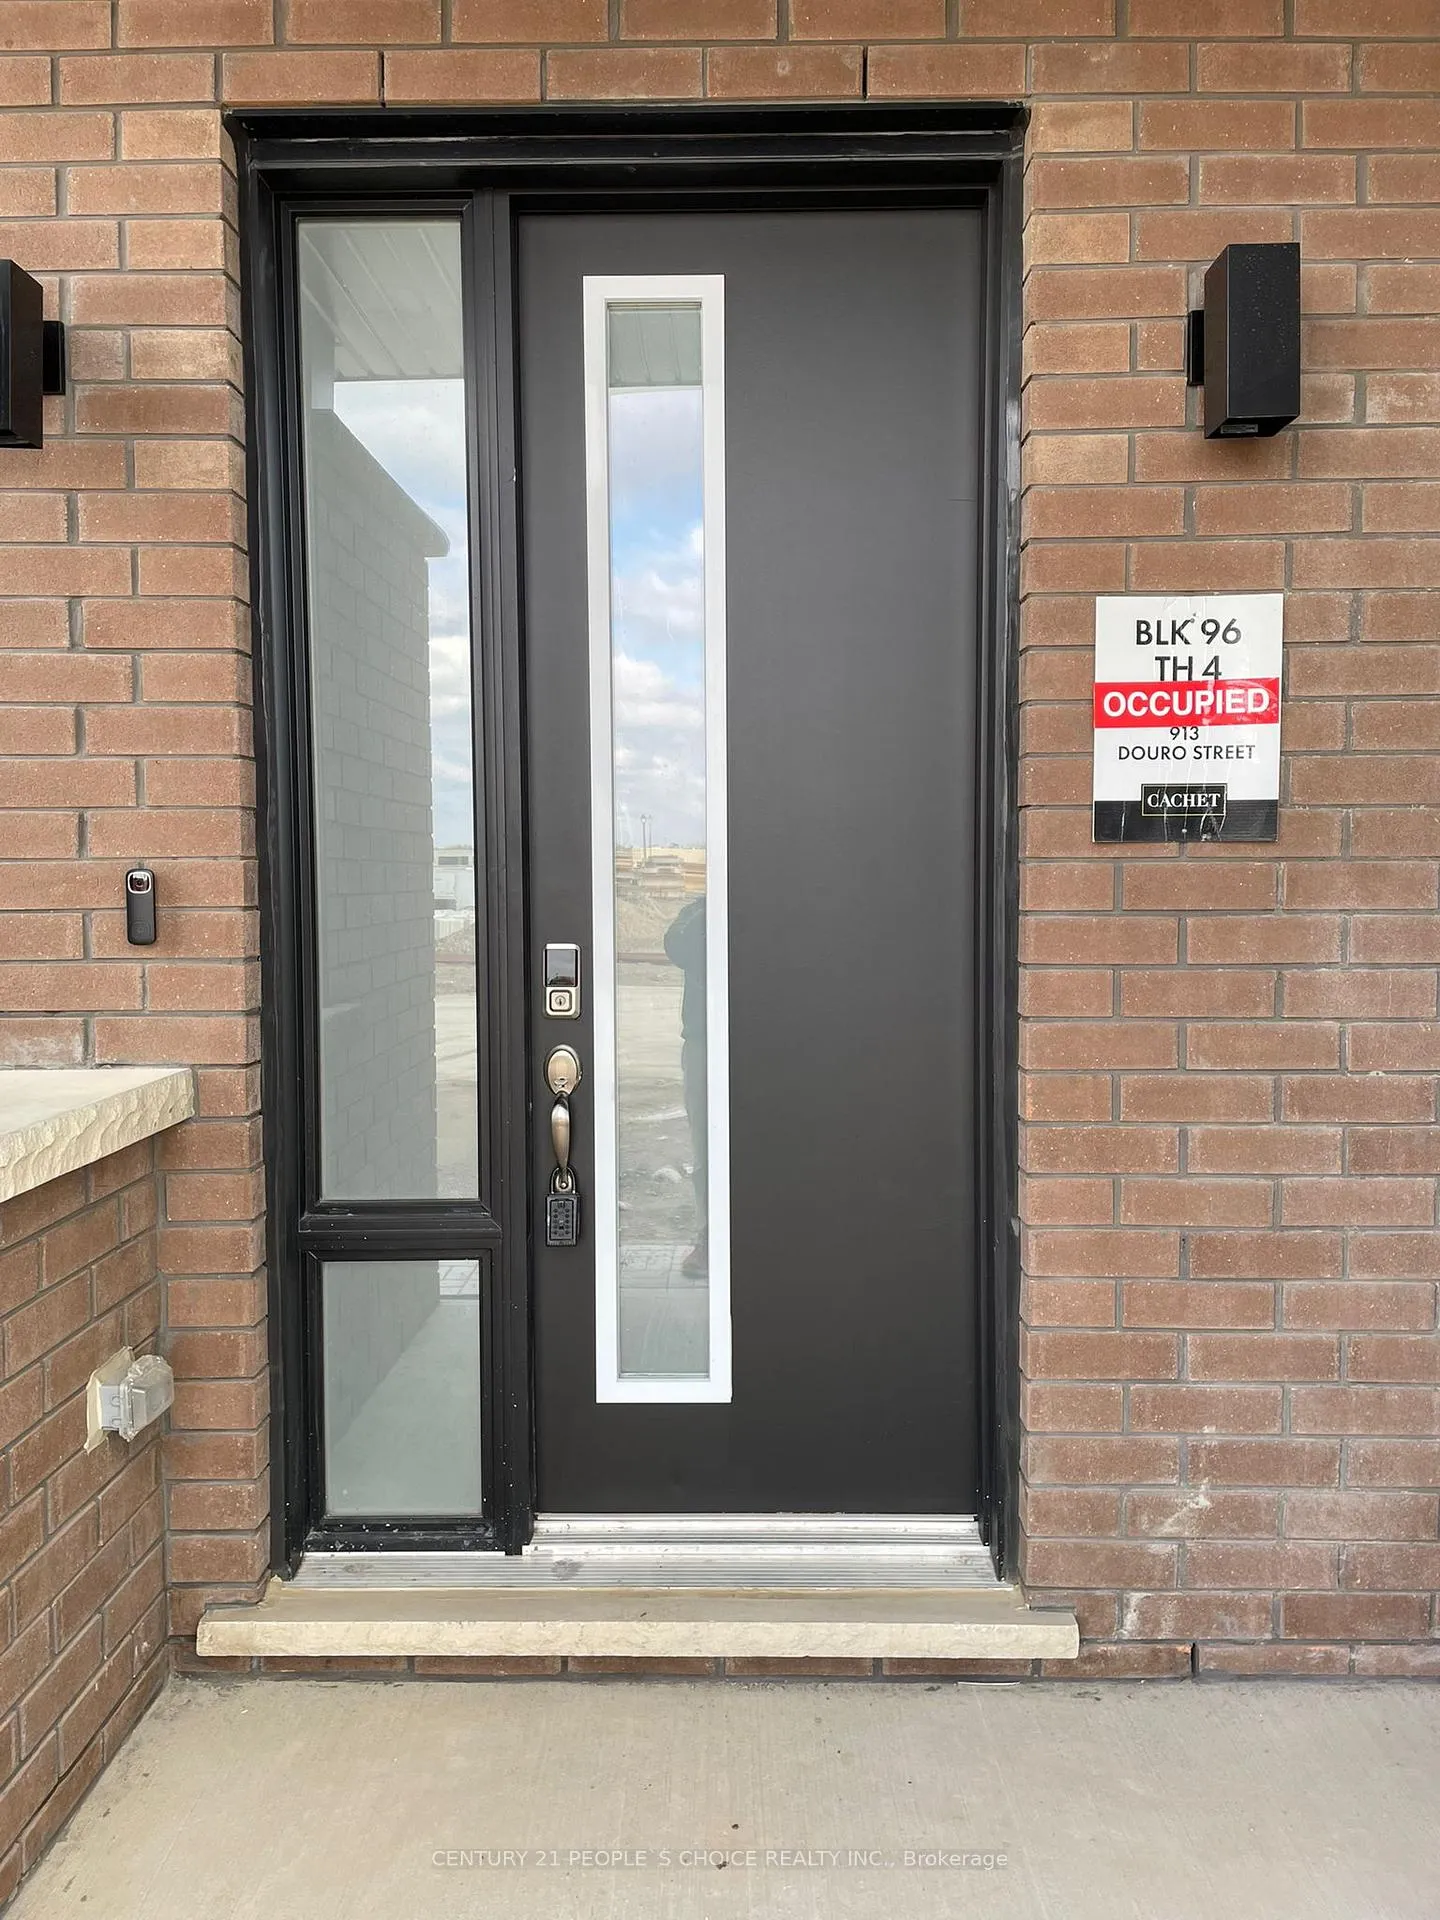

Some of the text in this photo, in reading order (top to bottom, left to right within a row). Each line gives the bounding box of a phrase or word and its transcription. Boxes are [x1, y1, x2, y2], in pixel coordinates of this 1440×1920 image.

[1135, 617, 1242, 645] BLK 96
[1154, 655, 1222, 681] TH 4
[1102, 687, 1270, 717] OCCUPIED
[1169, 726, 1200, 741] 913
[1118, 744, 1256, 760] DOURO STREET
[1147, 792, 1221, 808] CACHET
